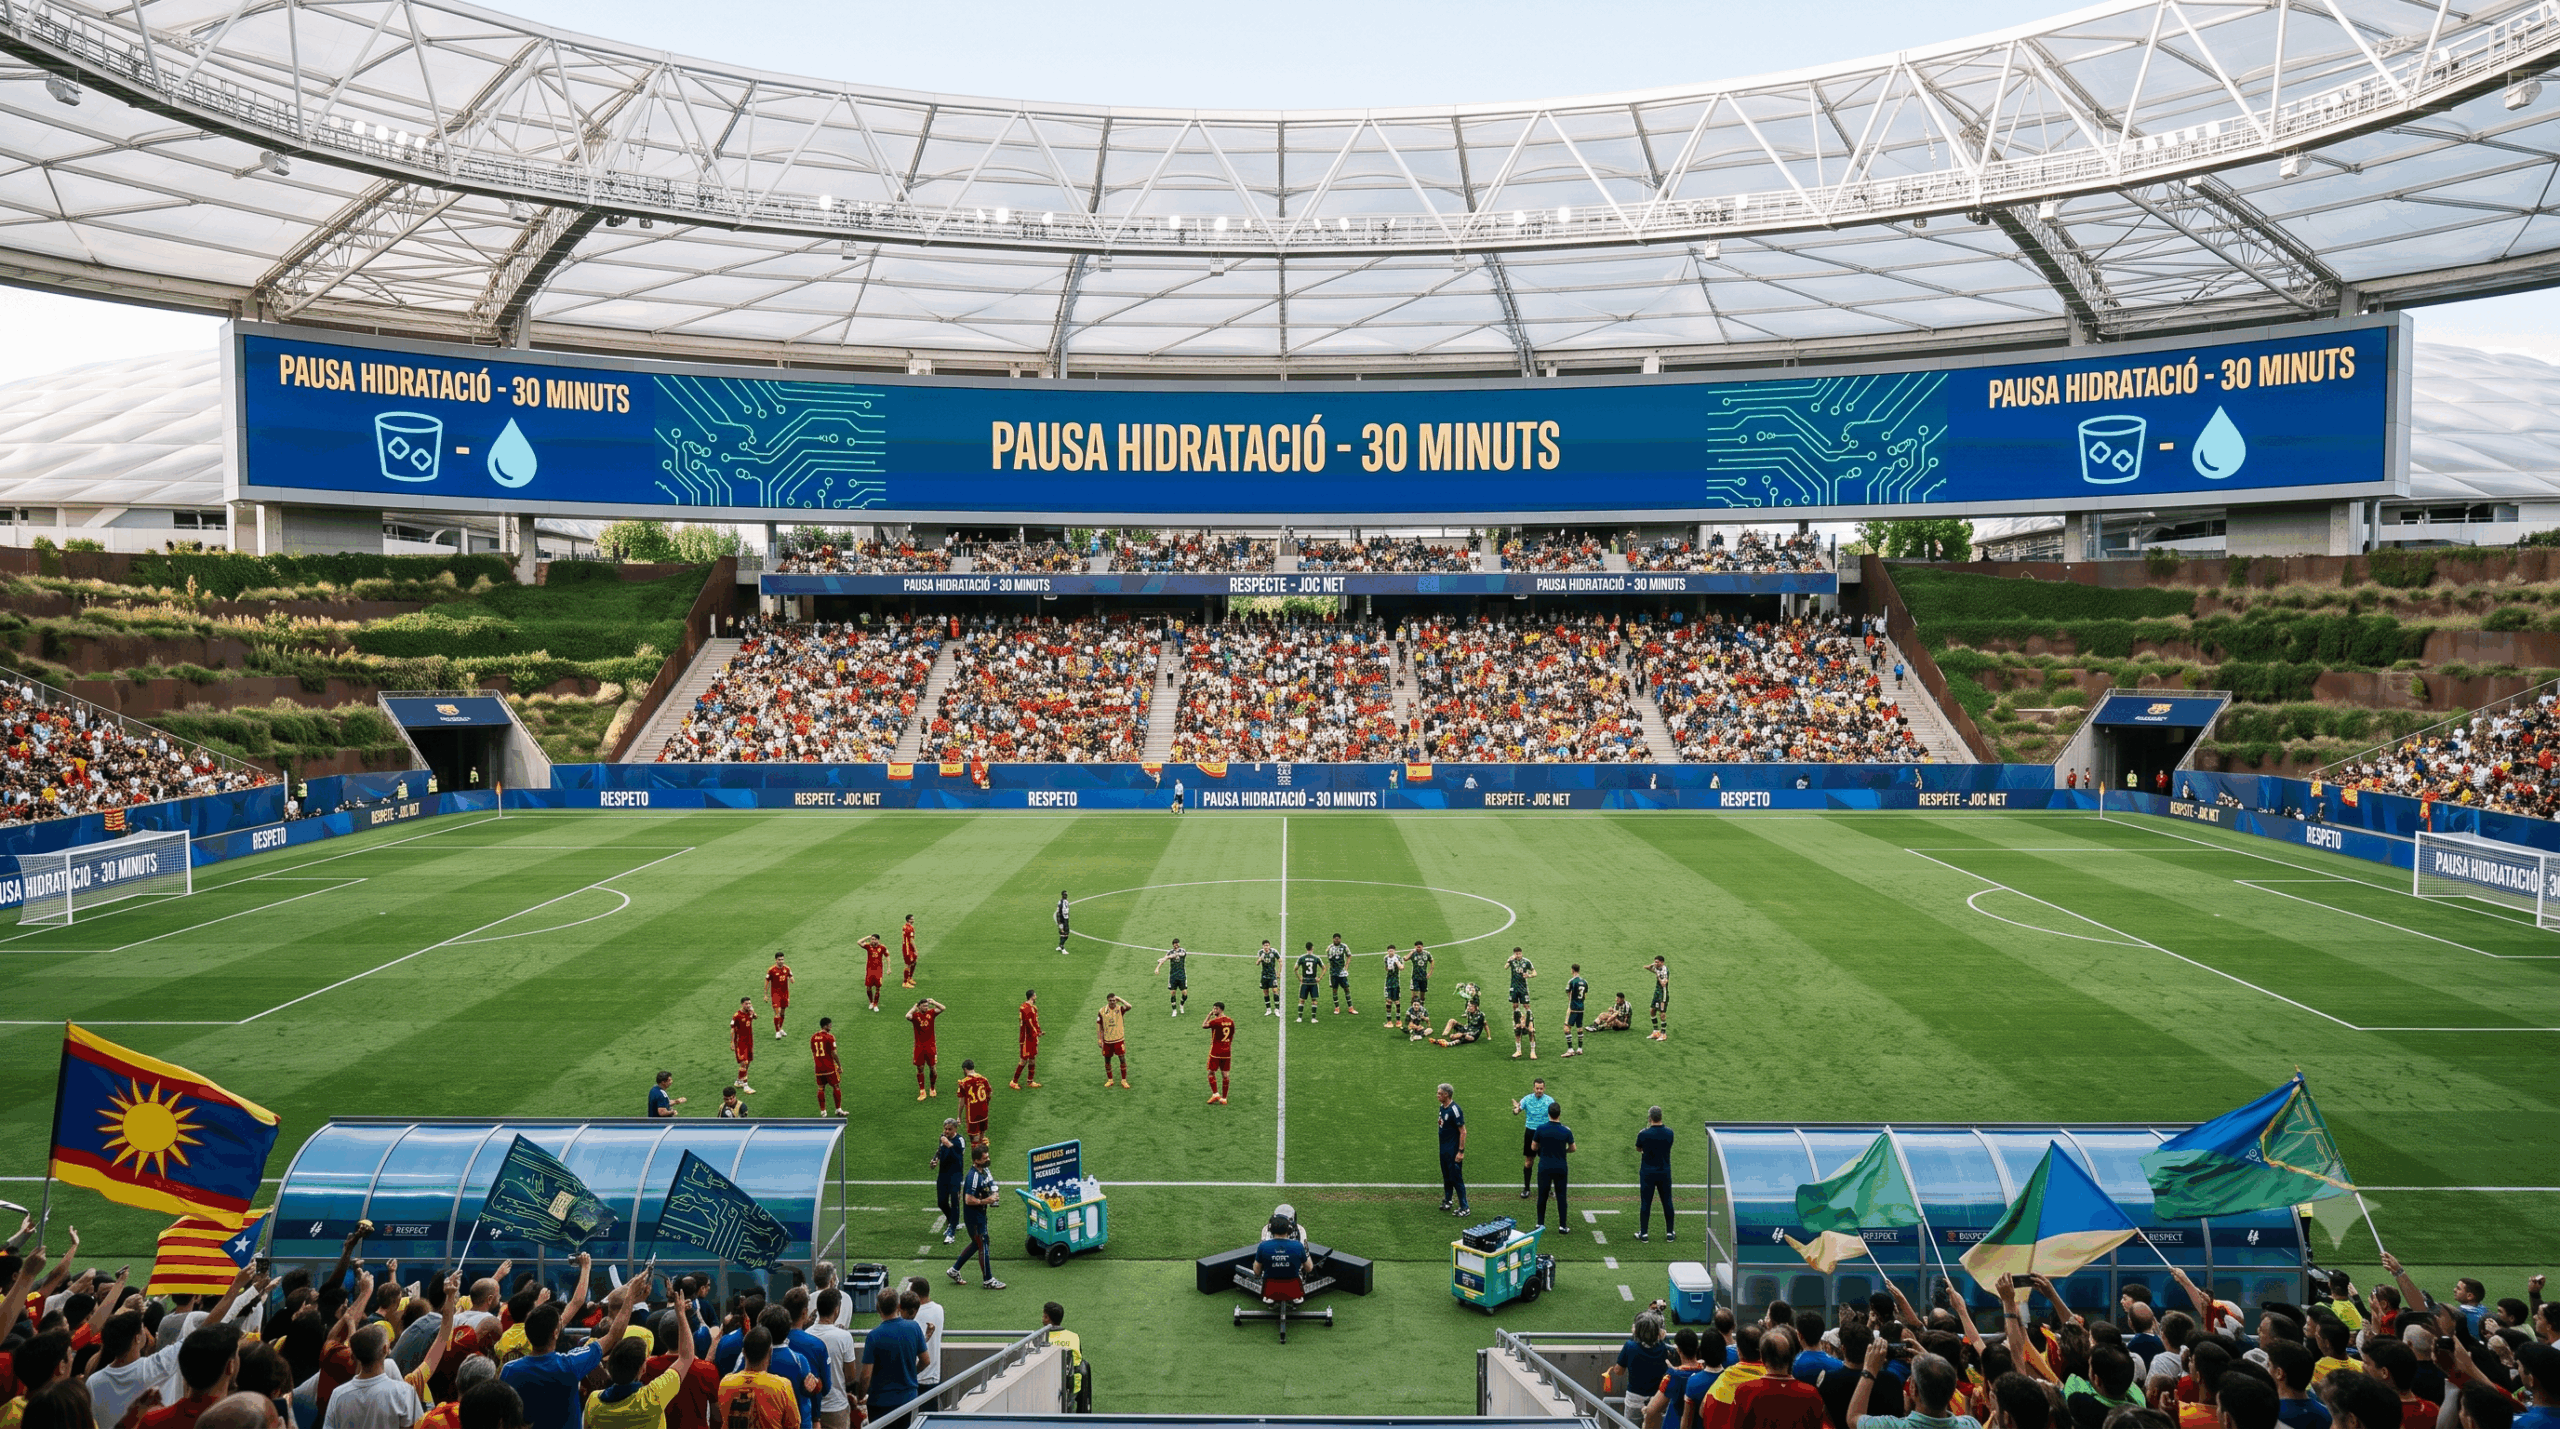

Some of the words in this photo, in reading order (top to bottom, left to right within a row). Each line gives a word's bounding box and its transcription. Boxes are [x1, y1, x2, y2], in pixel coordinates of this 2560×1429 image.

[280, 354, 356, 392] PAUSA
[360, 362, 491, 404] HIDRATACIÓ
[512, 376, 540, 407] 30
[546, 379, 630, 414] MINUTS
[1988, 375, 2060, 409] PAUSA
[2065, 356, 2198, 405] HIDRATACIÓ
[2221, 357, 2252, 391] 30
[2258, 346, 2356, 387] MINUTS
[992, 421, 1109, 472] PAUSA
[1118, 413, 1326, 473] HIDRATACIÓ
[1336, 444, 1352, 452] -
[1361, 422, 1407, 472] 30
[1418, 420, 1561, 471] MINUTS
[903, 578, 934, 592] PAUSA
[936, 576, 991, 592] HIDRATACIÓ
[999, 578, 1013, 592] 30
[1014, 578, 1051, 592] MINUTS
[1298, 577, 1321, 593] JOC
[1323, 577, 1346, 593] NET
[1536, 577, 1567, 591] PAUSA
[1568, 576, 1625, 591] HIDRATACIÓ
[1633, 577, 1648, 591] 30
[1649, 577, 1686, 591] MINUTS
[600, 791, 649, 807] RESPETO
[843, 792, 862, 806] JOC
[862, 792, 881, 806] NET
[1028, 791, 1078, 807] RESPETO
[1203, 791, 1240, 807] PAUSA
[1241, 789, 1307, 807] HIDRATACIÓ
[1316, 791, 1331, 807] 30
[1333, 791, 1377, 807] MINUTS
[1532, 793, 1551, 806] JOC
[1552, 793, 1571, 806] NET
[1720, 791, 1770, 807] RESPETO
[1968, 793, 1987, 806] JOC
[1988, 793, 2008, 806] NET
[252, 826, 287, 850] RESPETO
[2306, 825, 2342, 850] RESPETO
[101, 860, 116, 883] 30
[118, 852, 158, 880] MINUTS
[2435, 851, 2469, 878] PAUSA
[2470, 858, 2539, 893] HIDRATACIÓ
[1305, 961, 1314, 975] 3
[1577, 985, 1586, 1000] 3
[395, 1226, 430, 1235] RESPECT
